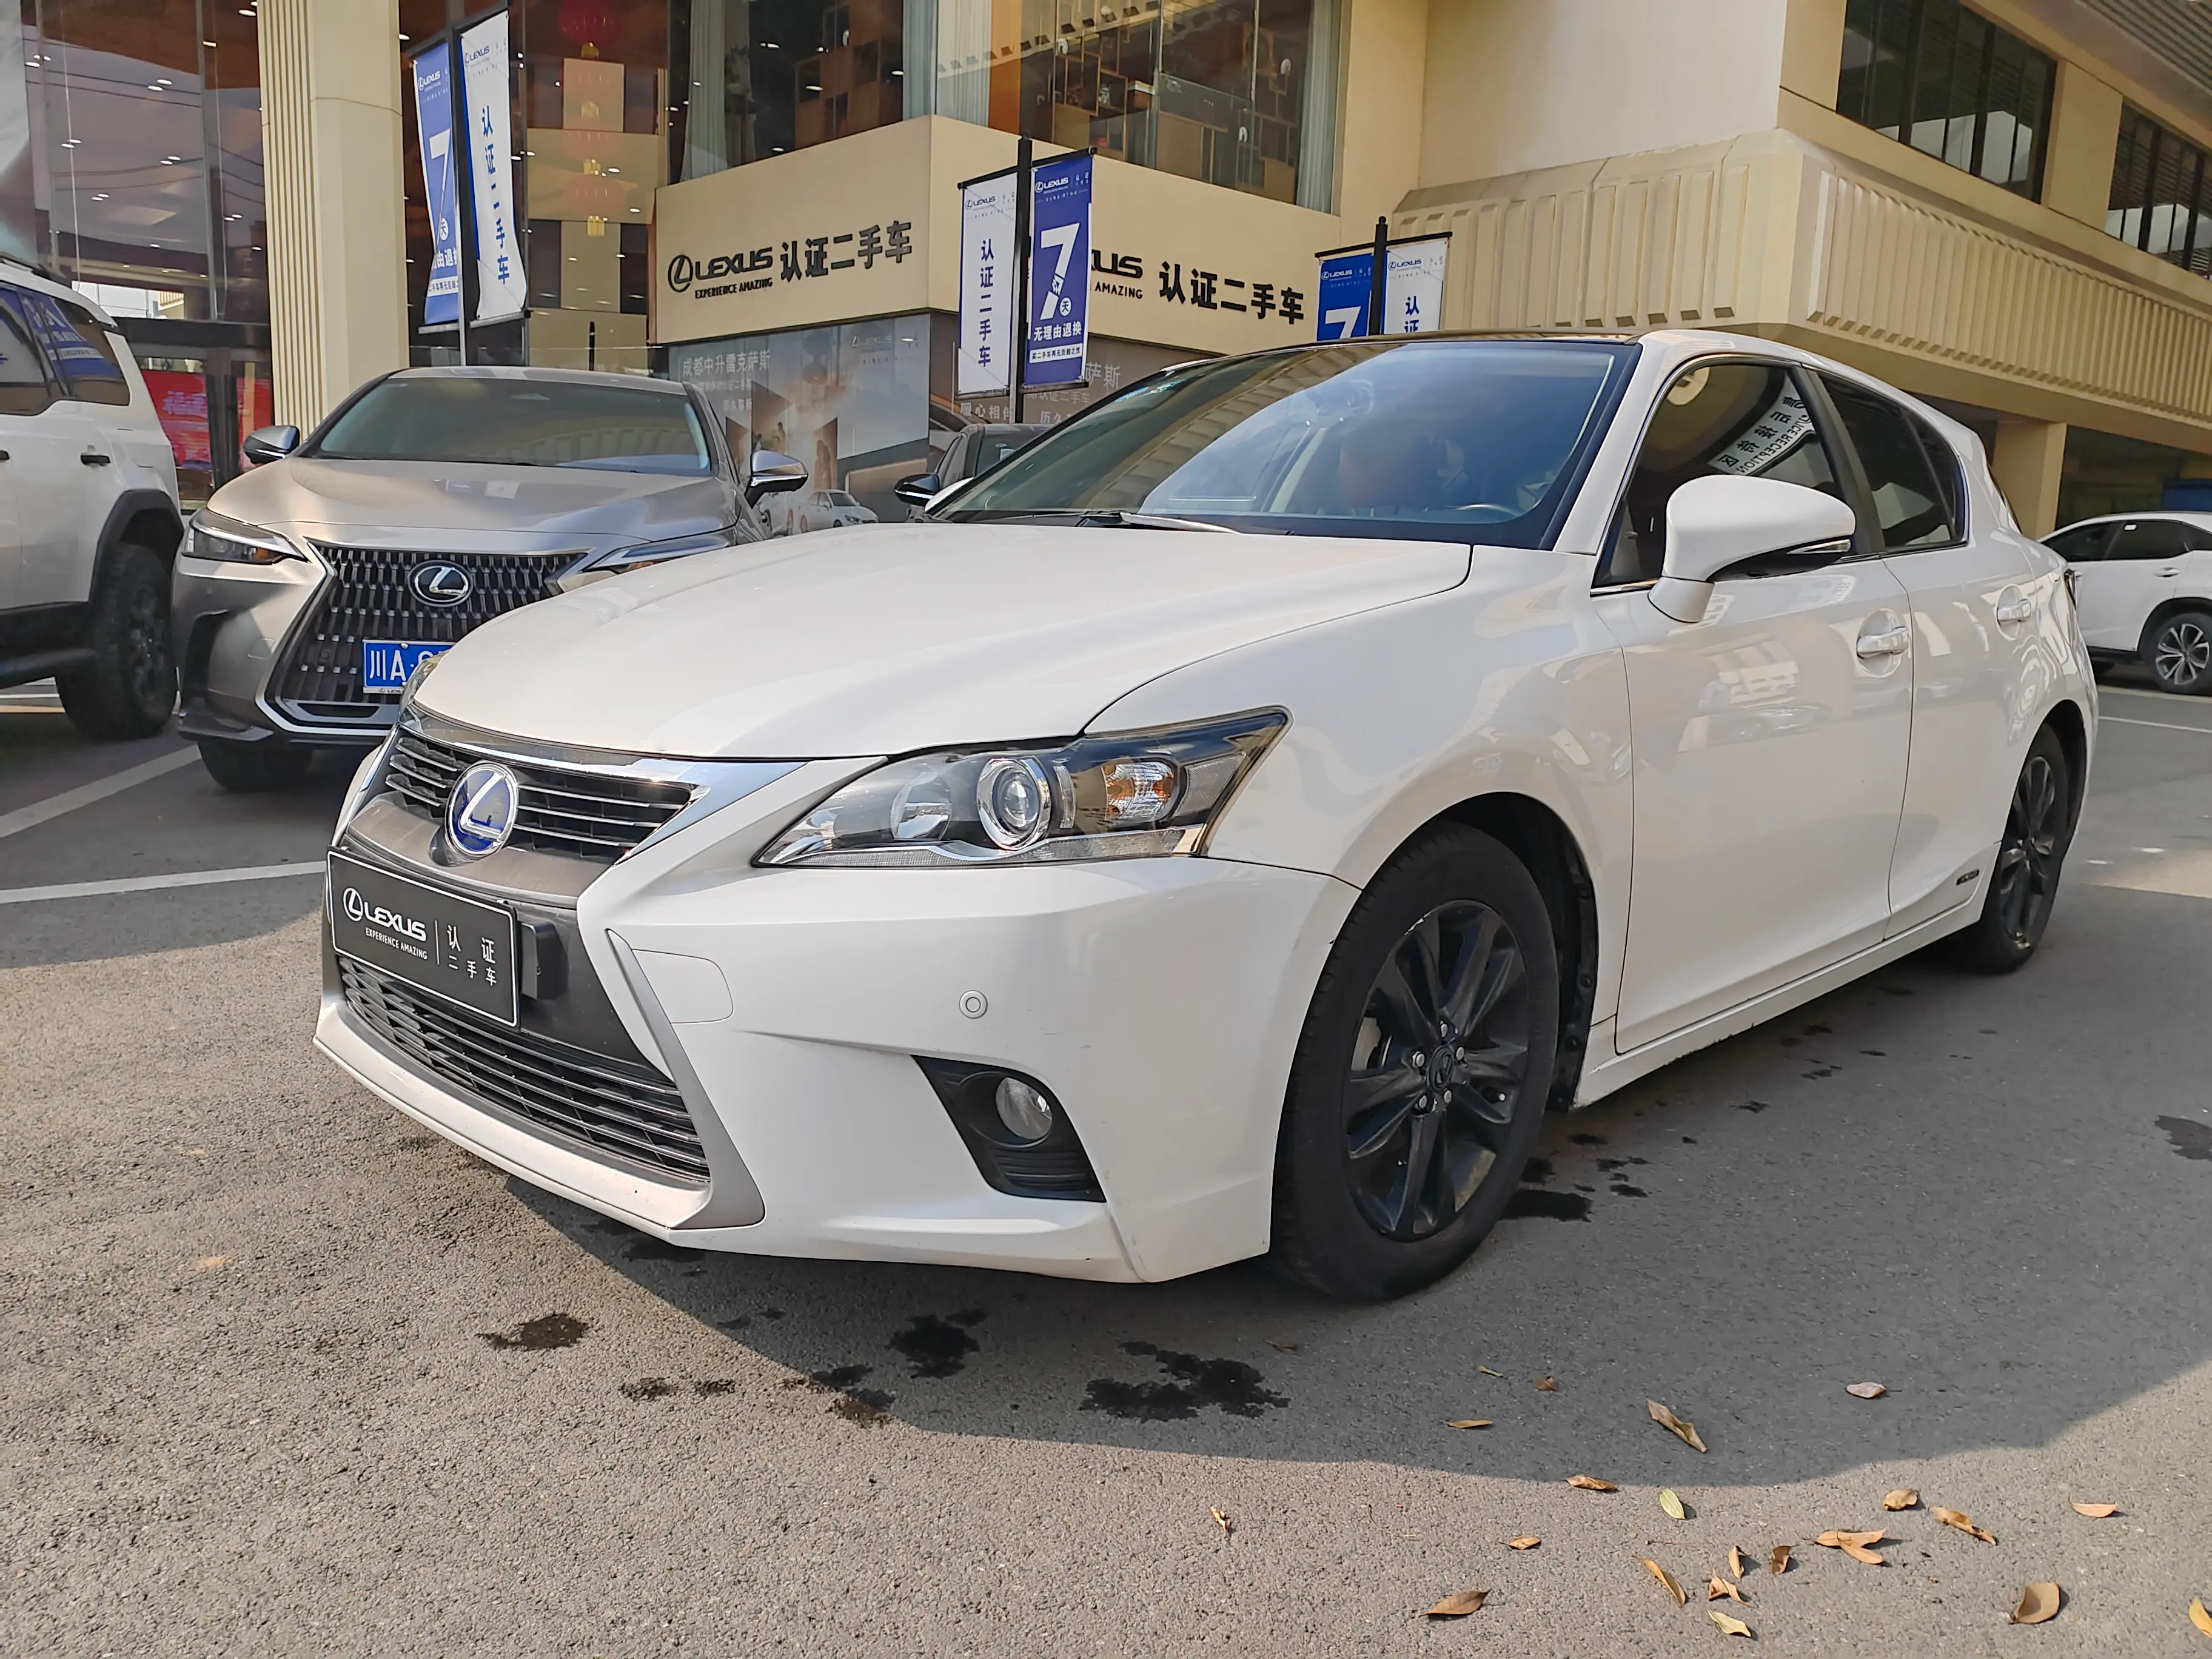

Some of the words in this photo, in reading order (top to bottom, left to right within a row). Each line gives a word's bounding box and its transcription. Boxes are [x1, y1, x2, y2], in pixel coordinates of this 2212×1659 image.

[470, 45, 490, 61] LEXUS
[424, 70, 441, 85] LEXUS
[482, 106, 509, 284] 认证二手车
[1044, 177, 1069, 189] LEXUS
[973, 196, 996, 206] LEXUS
[695, 247, 773, 280] LEXUS
[780, 220, 912, 283] 认证二手车
[1396, 259, 1422, 267] LEXUS
[1040, 223, 1079, 320] 7
[1329, 269, 1353, 278] LEXUS
[695, 283, 738, 299] EXPERIENCE
[739, 277, 773, 292] AMAZING
[1095, 281, 1143, 299] AMAZING
[1159, 261, 1304, 324] 认证二手车
[978, 238, 994, 367] 认证二手车
[1033, 321, 1082, 341] 无理由退换
[683, 349, 771, 378] 成都中升雷克萨斯
[1040, 411, 1073, 424] 历久
[364, 902, 427, 942] LEXUS
[366, 927, 400, 948] EXPERIENCE
[400, 942, 427, 960] AMAZING
[447, 925, 496, 964] 认证
[448, 954, 497, 987] 二手车
